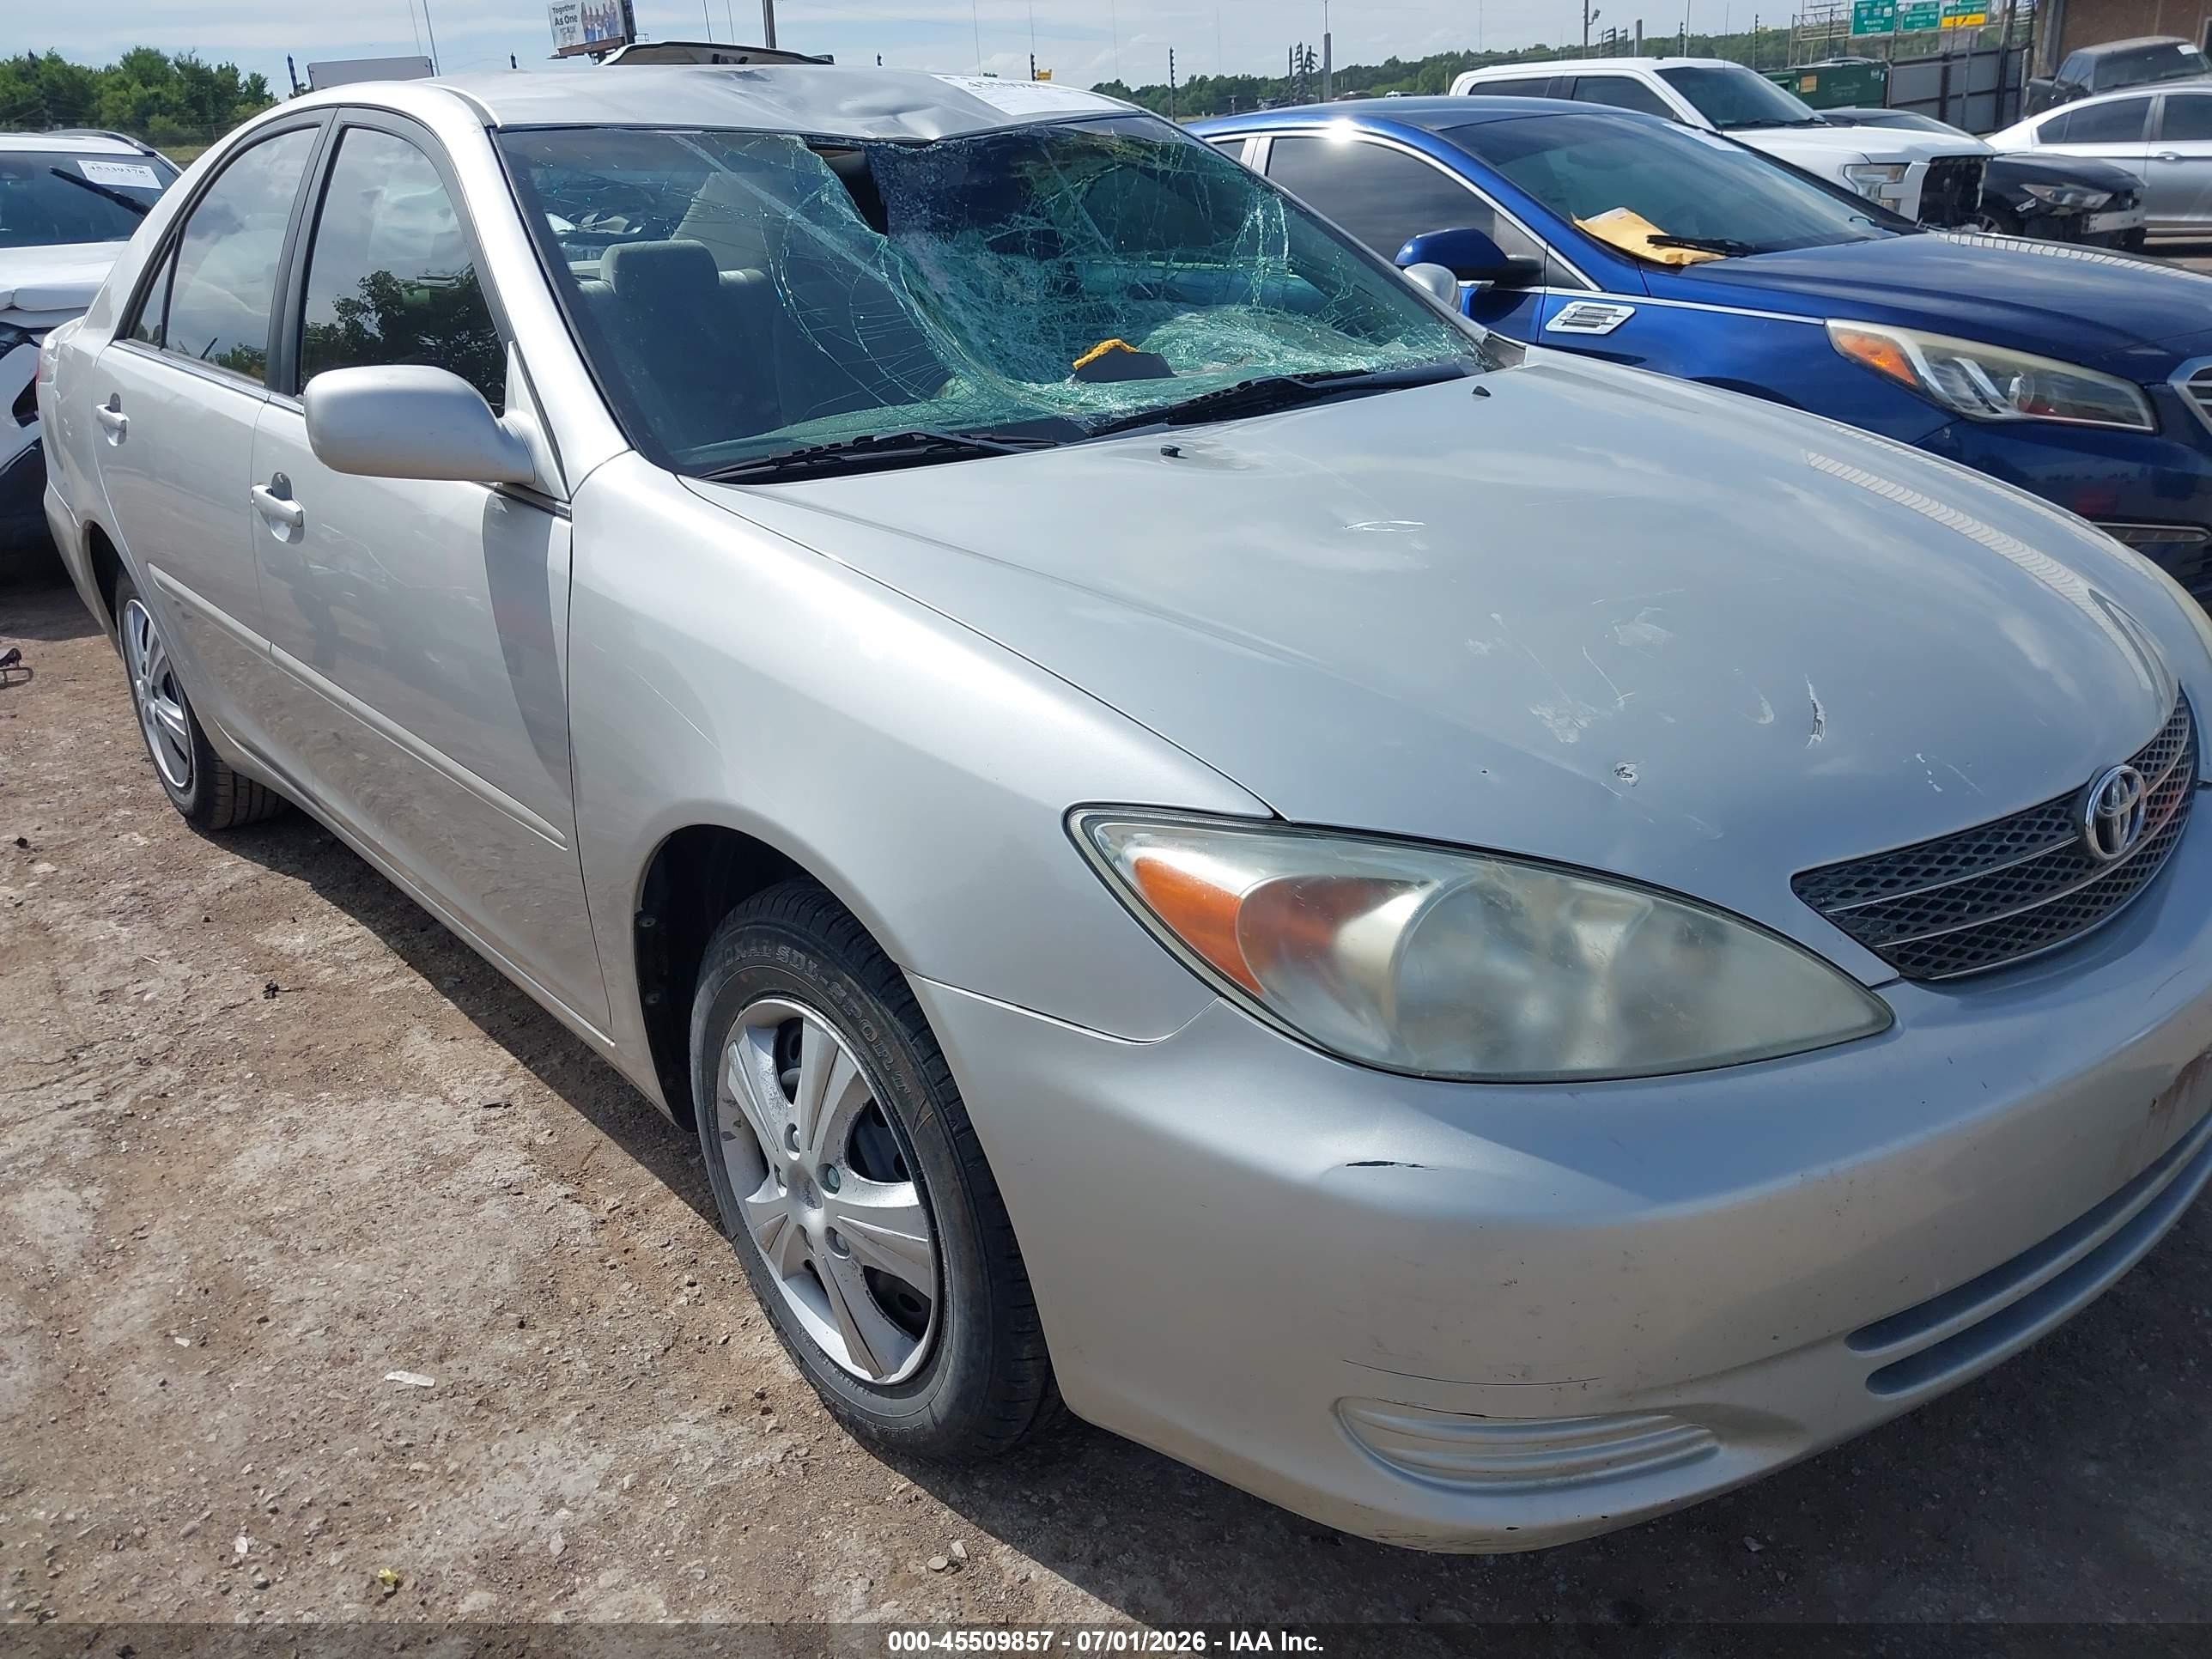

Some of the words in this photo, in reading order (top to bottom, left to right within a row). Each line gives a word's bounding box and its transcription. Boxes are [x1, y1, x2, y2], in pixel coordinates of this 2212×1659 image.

[551, 3, 576, 15] Together
[555, 17, 564, 27] As
[564, 15, 579, 25] One
[775, 944, 912, 1095] SDL-SPORT
